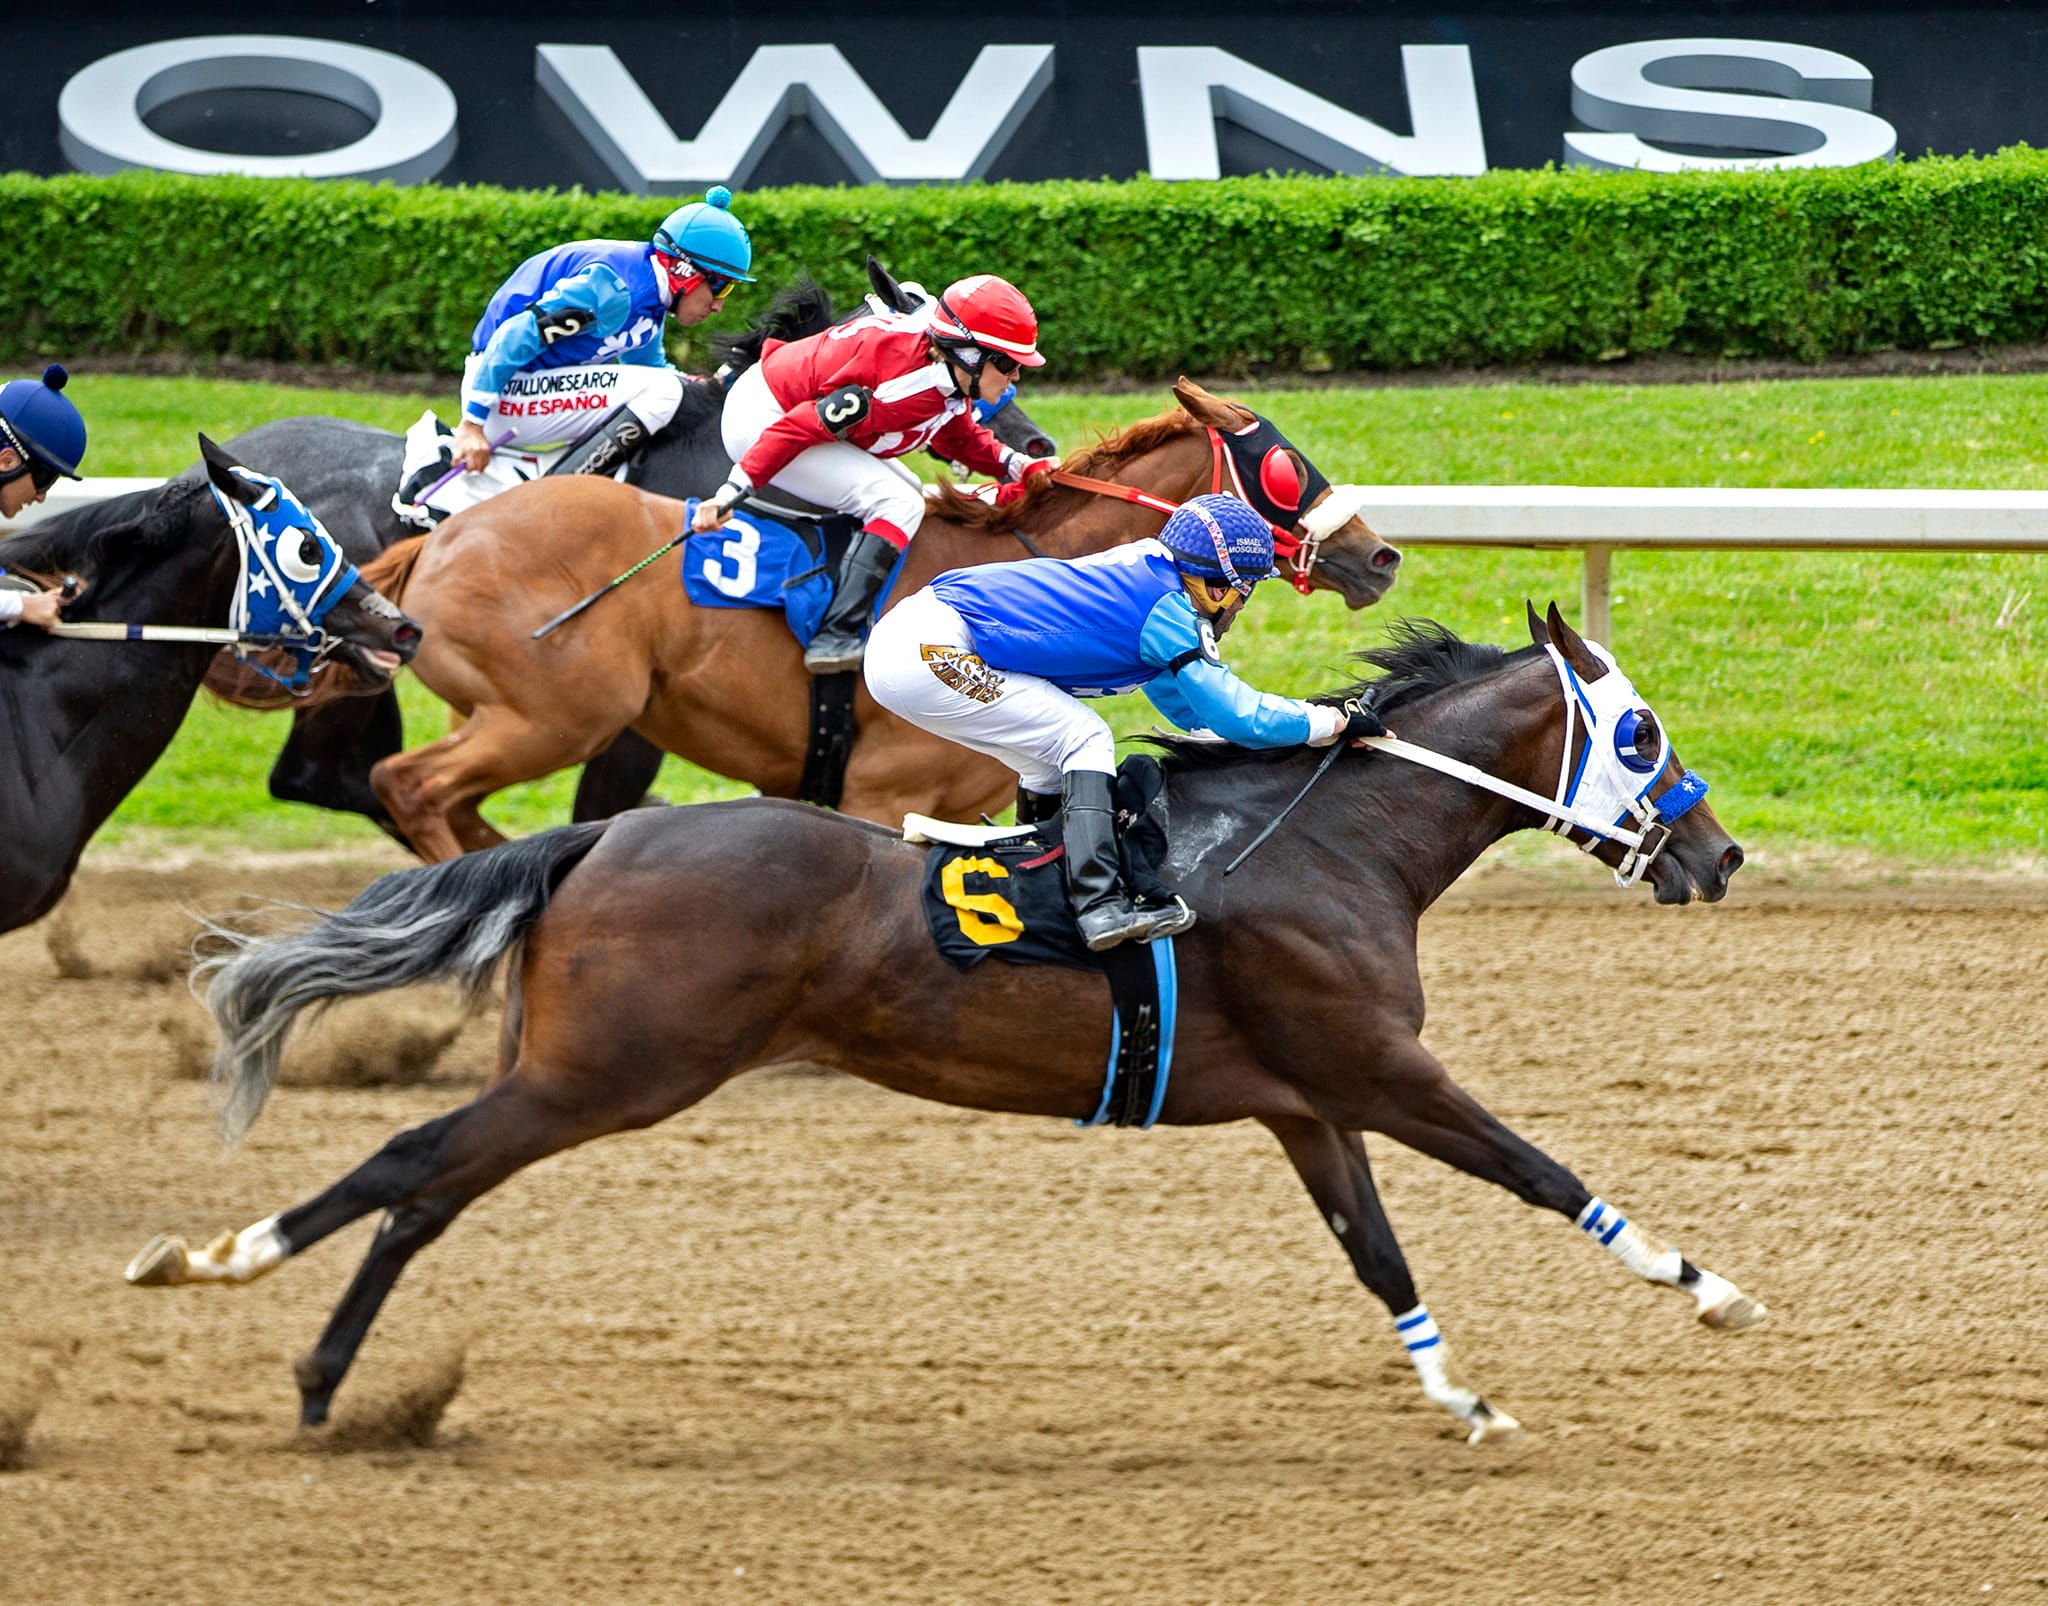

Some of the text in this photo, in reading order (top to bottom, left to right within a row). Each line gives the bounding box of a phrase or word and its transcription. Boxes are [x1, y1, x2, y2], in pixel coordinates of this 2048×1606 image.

[58, 35, 1897, 186] OWNS
[543, 318, 581, 345] 2
[503, 372, 618, 396] STALLIONESEARCH
[498, 390, 609, 417] EN ESPAÑOL
[824, 392, 861, 424] 3
[1228, 546, 1267, 554] MOSQUERA
[1236, 538, 1262, 546] ISMAEL
[702, 517, 761, 599] 3
[1200, 623, 1220, 661] 6
[941, 854, 1025, 946] 6
